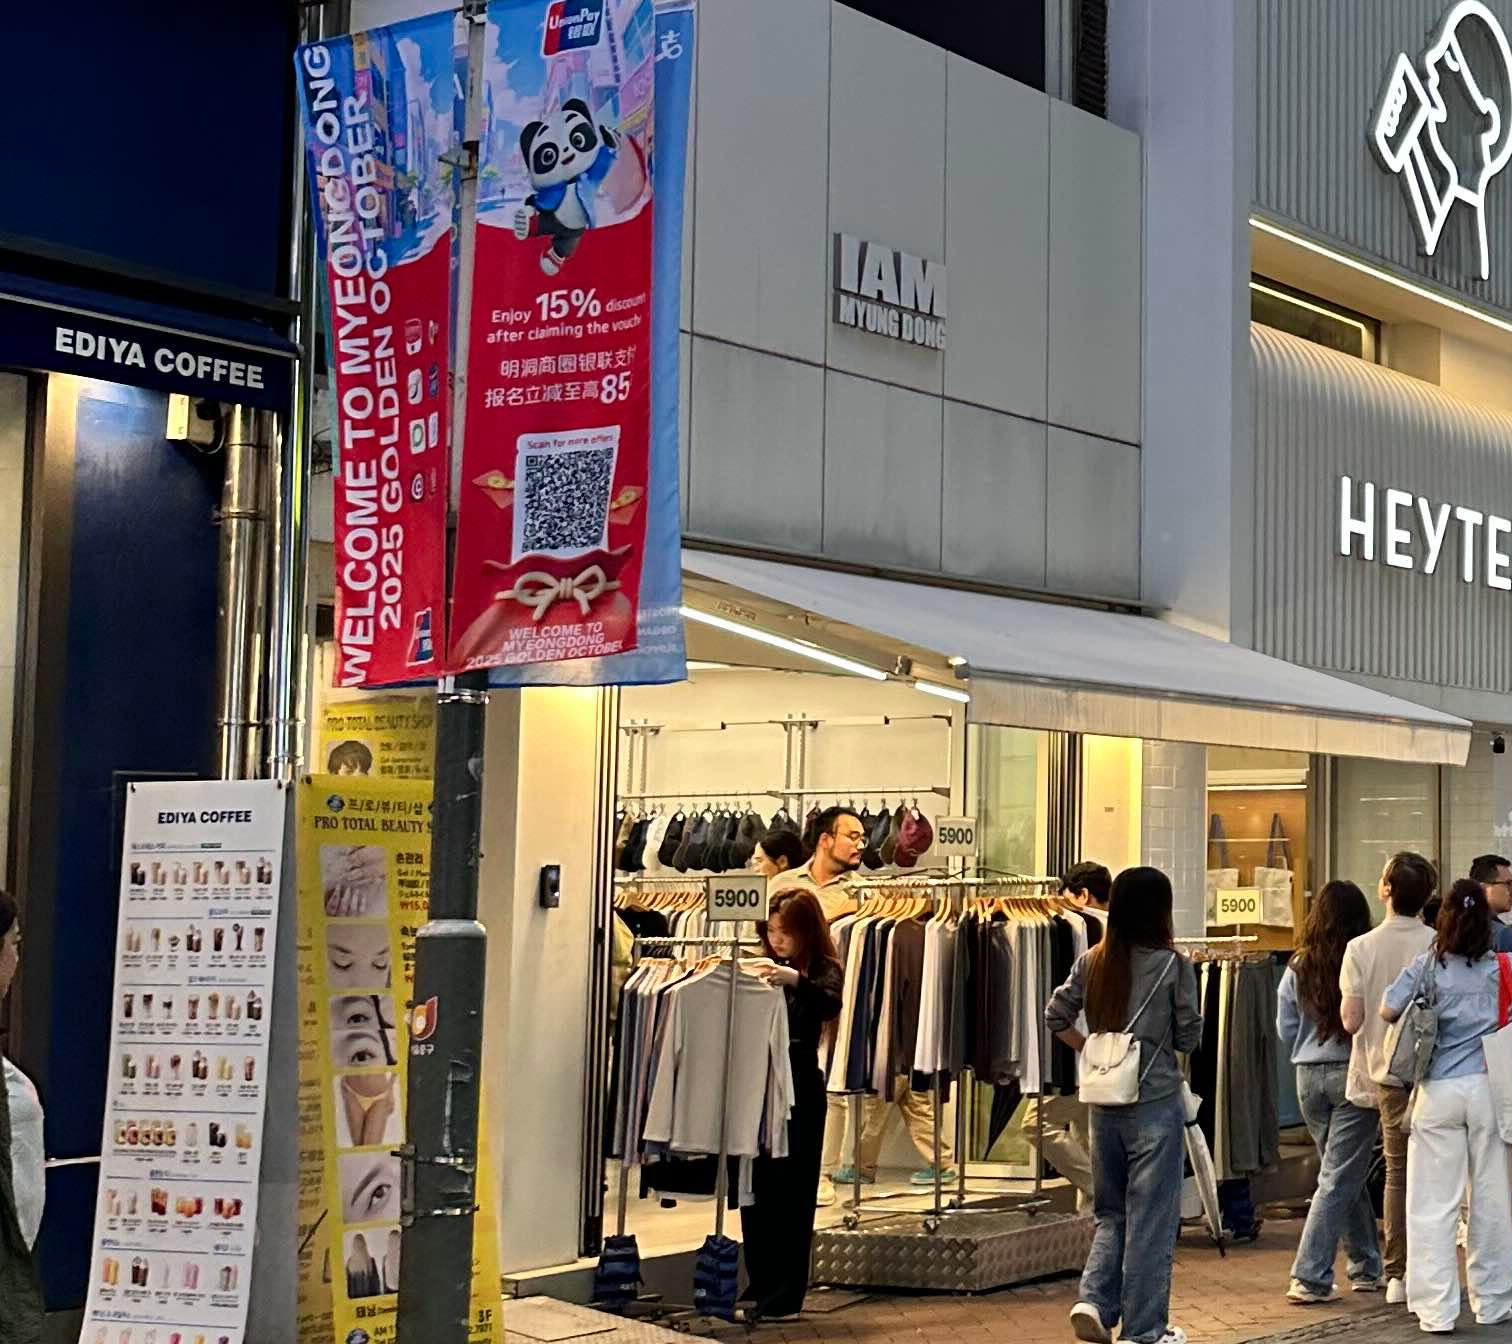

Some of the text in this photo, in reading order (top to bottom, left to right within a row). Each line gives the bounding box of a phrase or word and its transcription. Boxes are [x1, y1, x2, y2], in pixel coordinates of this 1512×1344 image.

[491, 308, 532, 326] Enjoy
[535, 287, 602, 321] 15%
[486, 329, 525, 344] after
[527, 324, 583, 342] claiming
[586, 321, 609, 334] the
[838, 295, 946, 350] MYUNG DONG
[56, 326, 264, 389] EDIYA COFFEE
[303, 45, 379, 686] WELCOME TO MYEONGDONG
[344, 93, 404, 630] 2025 GOLDEN OCTOBER
[527, 440, 551, 449] Scan
[508, 621, 603, 640] WELCOME TO
[502, 632, 605, 652] MYEONGDONG
[504, 648, 568, 665] GOLDEN
[157, 810, 253, 824] EDIYA COFFEE
[314, 815, 424, 834] PRO TOTAL BEAUTY
[938, 826, 974, 846] 5900
[714, 888, 760, 908] 5900
[1220, 897, 1257, 913] 5900
